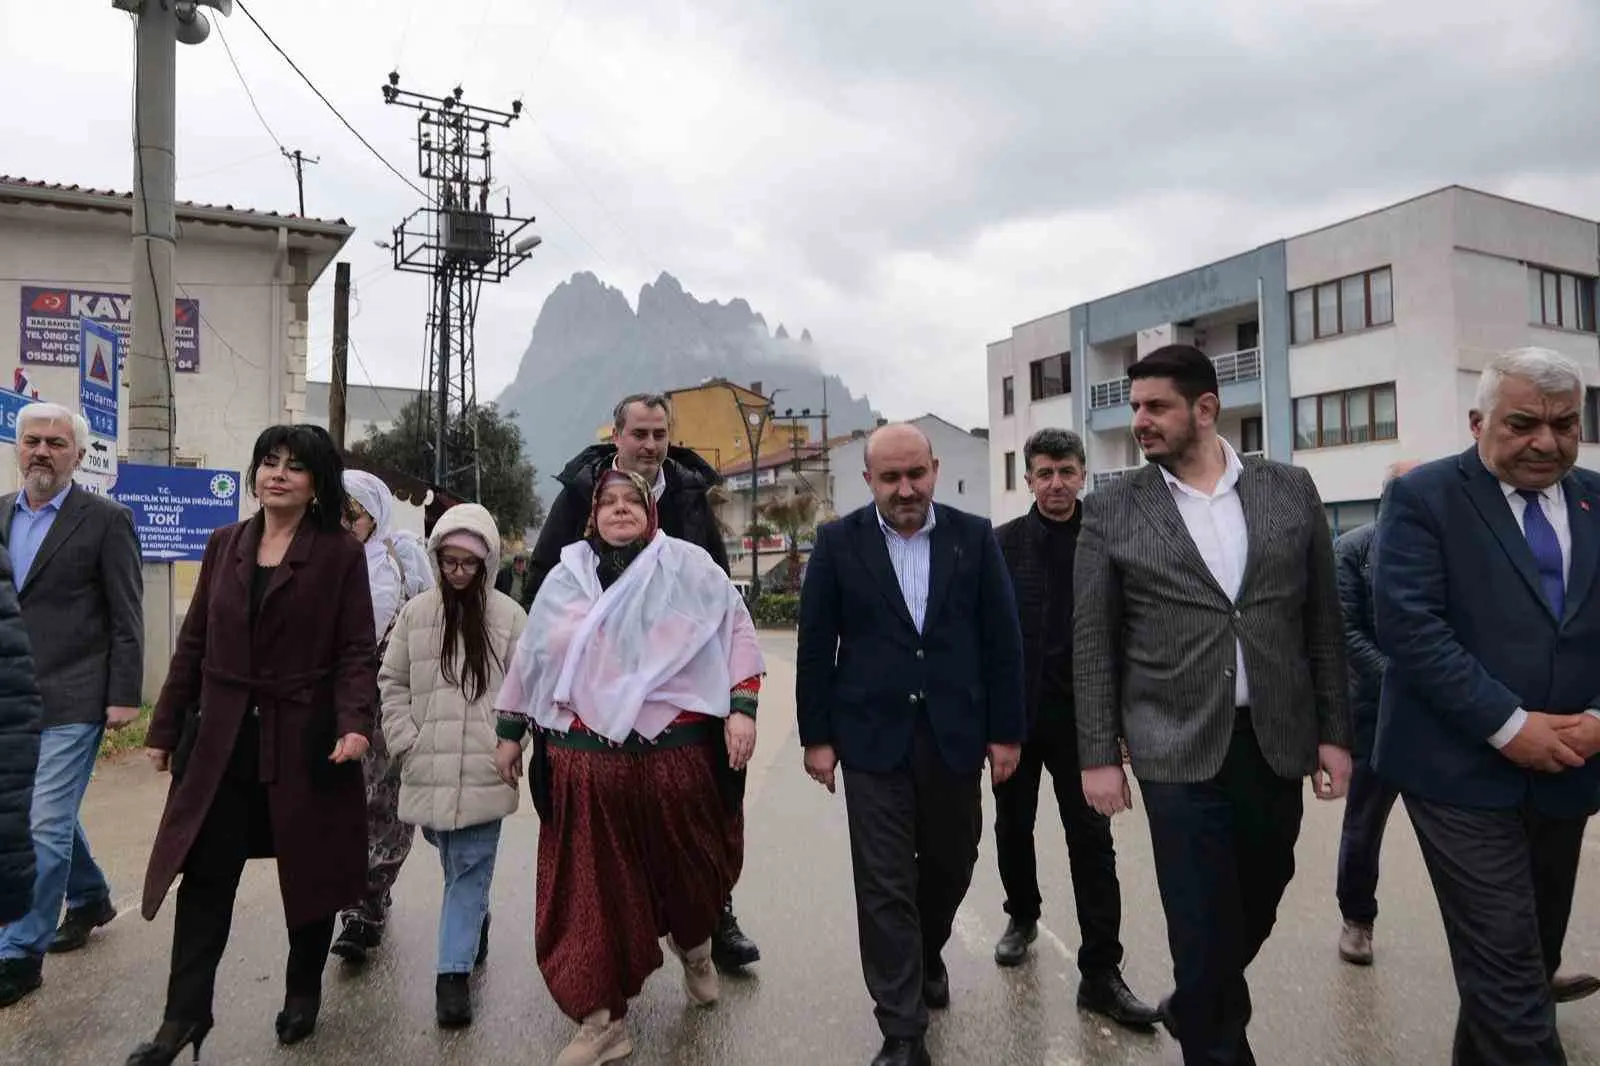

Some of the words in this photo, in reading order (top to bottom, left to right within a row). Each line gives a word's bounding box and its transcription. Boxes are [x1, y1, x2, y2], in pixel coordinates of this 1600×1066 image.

[26, 330, 42, 339] TEL
[81, 387, 117, 410] Jandarma
[95, 415, 113, 431] 112
[88, 454, 101, 467] 700
[146, 511, 179, 526] TOKİ
